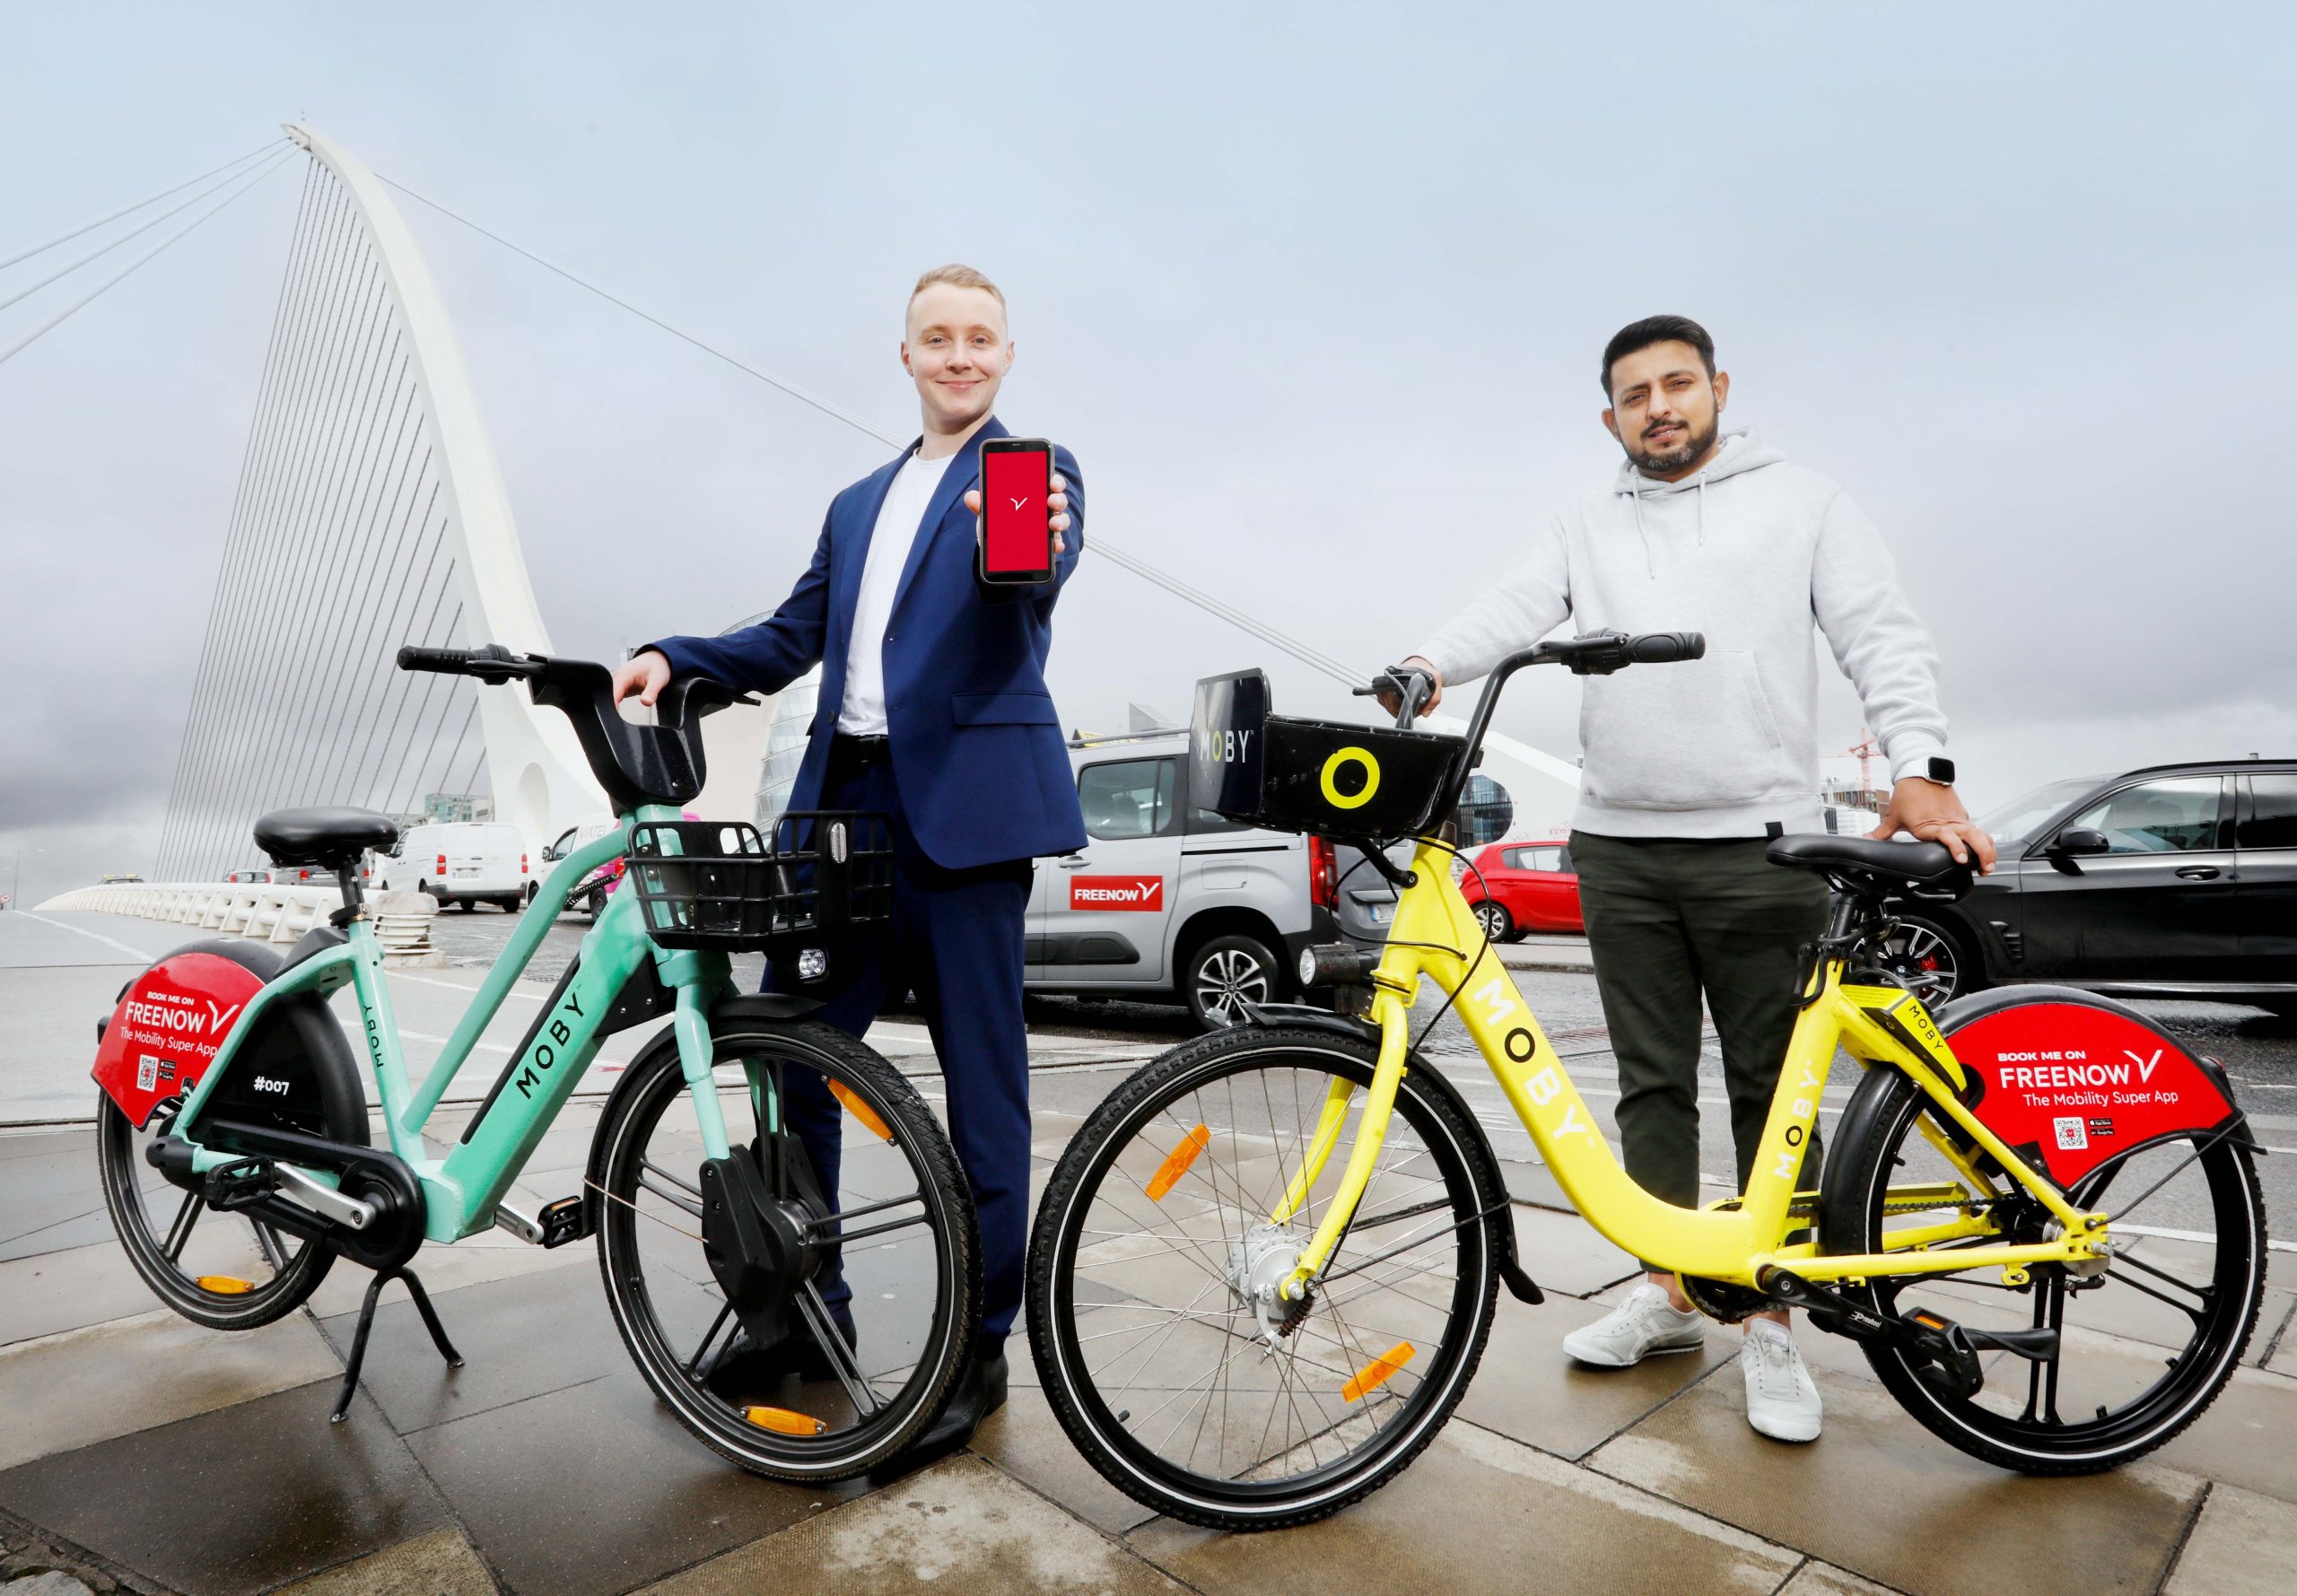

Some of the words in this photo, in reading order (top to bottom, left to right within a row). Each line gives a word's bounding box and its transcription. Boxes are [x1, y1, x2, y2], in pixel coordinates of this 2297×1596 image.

[1200, 730, 1249, 763] MOBY
[1074, 889, 1139, 902] FREENOW
[147, 991, 167, 1001] BOOK
[168, 995, 180, 1004] ME
[181, 997, 195, 1006] ON
[125, 1001, 206, 1033] FREENOW
[1908, 1005, 1943, 1050] MOBY
[120, 1026, 133, 1040] The
[134, 1030, 166, 1049] Mobility
[167, 1036, 195, 1052] Super
[196, 1042, 218, 1058] App
[363, 1005, 384, 1068] MOBY
[515, 992, 584, 1100] MOBY
[1473, 977, 1587, 1139] MOBY
[1997, 1052, 2038, 1061] BOOK
[2040, 1051, 2063, 1060] ME
[2065, 1051, 2086, 1060] ON
[253, 1076, 290, 1095] #007
[1999, 1064, 2129, 1088] FREENOW
[2022, 1094, 2050, 1106] The
[2053, 1091, 2109, 1107] Mobility
[2112, 1091, 2151, 1105] Super
[2154, 1090, 2179, 1104] App
[1774, 1068, 1821, 1180] MOBY
